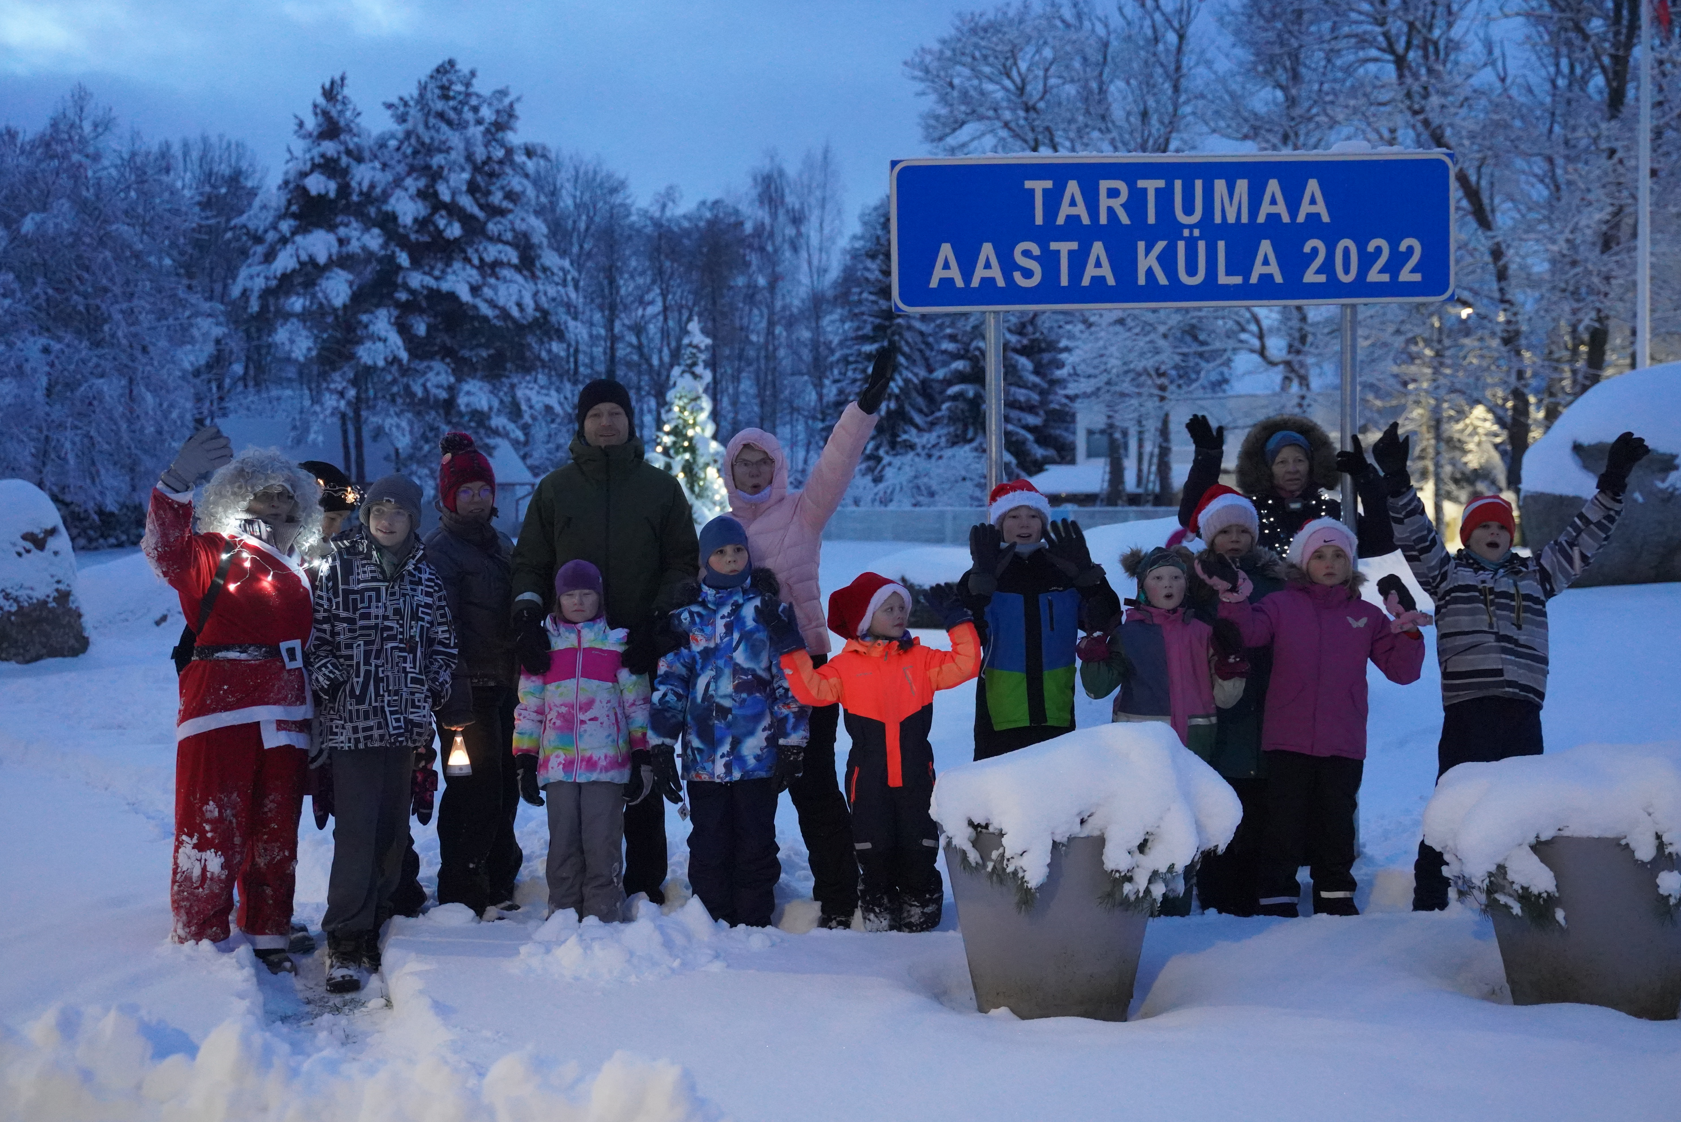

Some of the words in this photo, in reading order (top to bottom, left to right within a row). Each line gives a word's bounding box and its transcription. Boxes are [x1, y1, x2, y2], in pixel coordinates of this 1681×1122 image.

[1024, 178, 1331, 225] TARTUMAA
[928, 241, 1116, 288] AASTA
[1136, 228, 1284, 286] KÜLA
[1302, 237, 1423, 284] 2022
